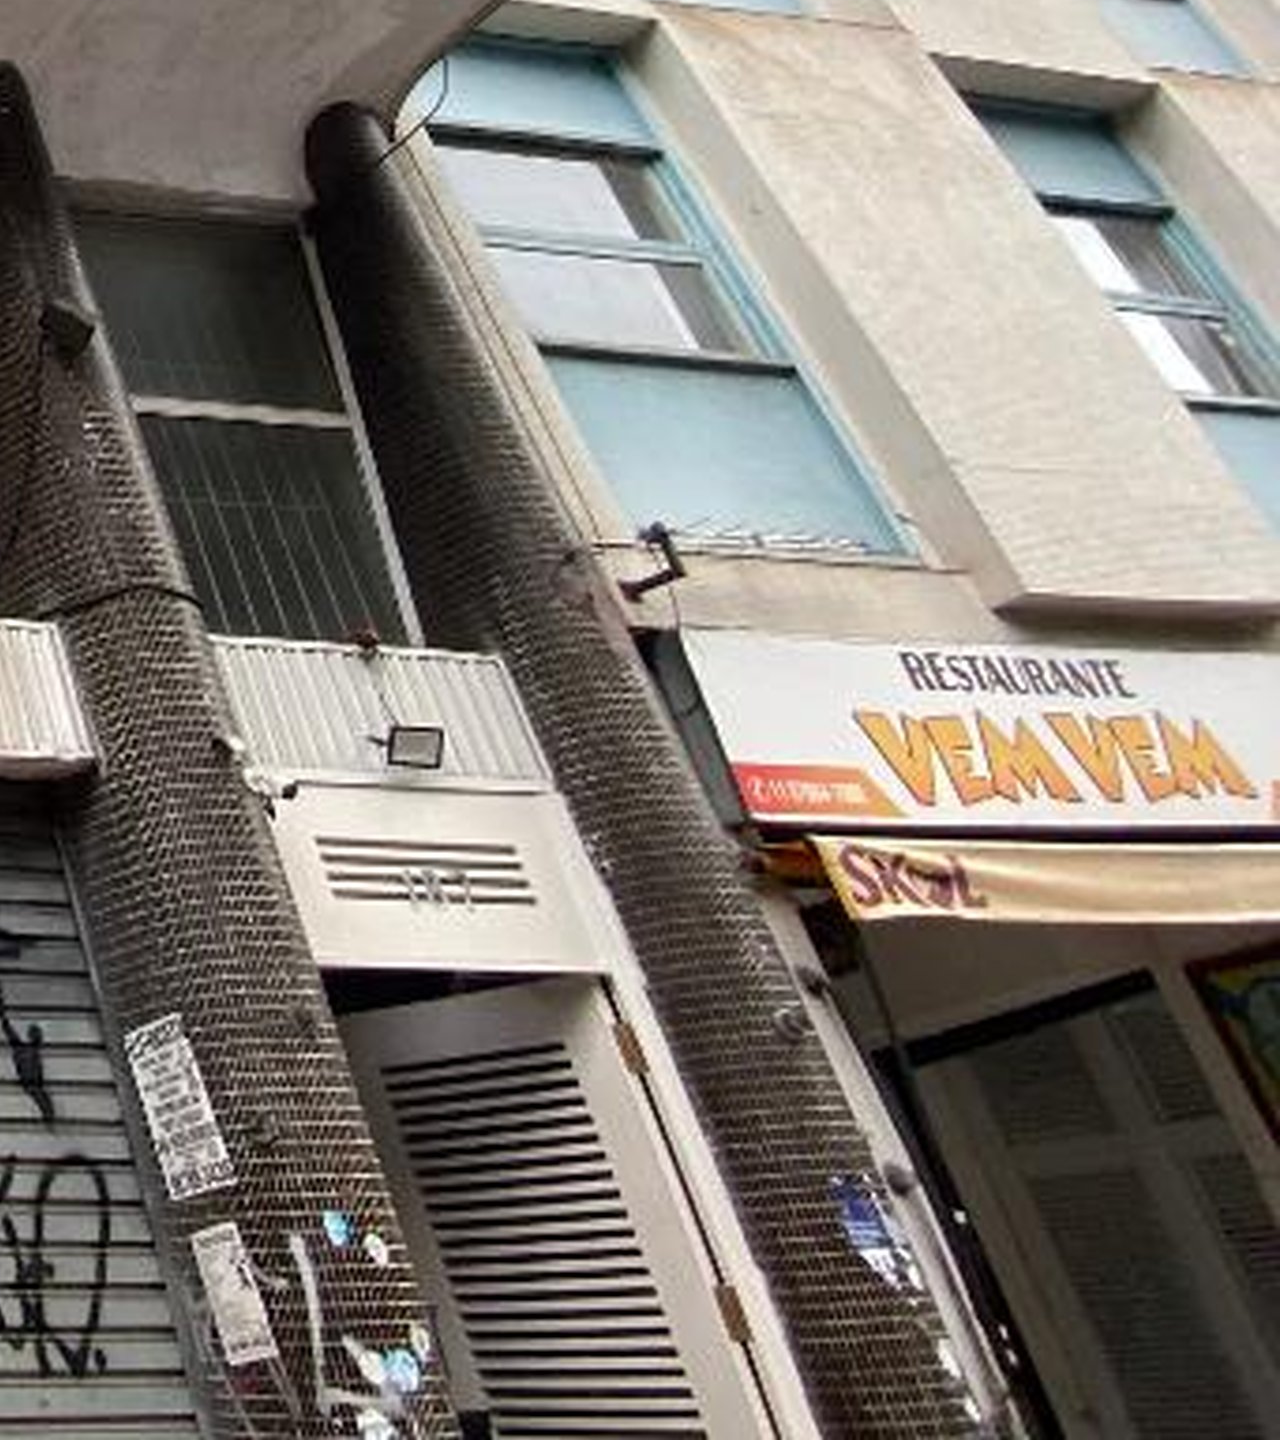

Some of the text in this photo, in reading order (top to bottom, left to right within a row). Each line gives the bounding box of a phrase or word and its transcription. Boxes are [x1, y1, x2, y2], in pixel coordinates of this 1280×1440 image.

[900, 652, 1137, 698] RESTAURANTE
[853, 709, 1259, 807] VEM VEM
